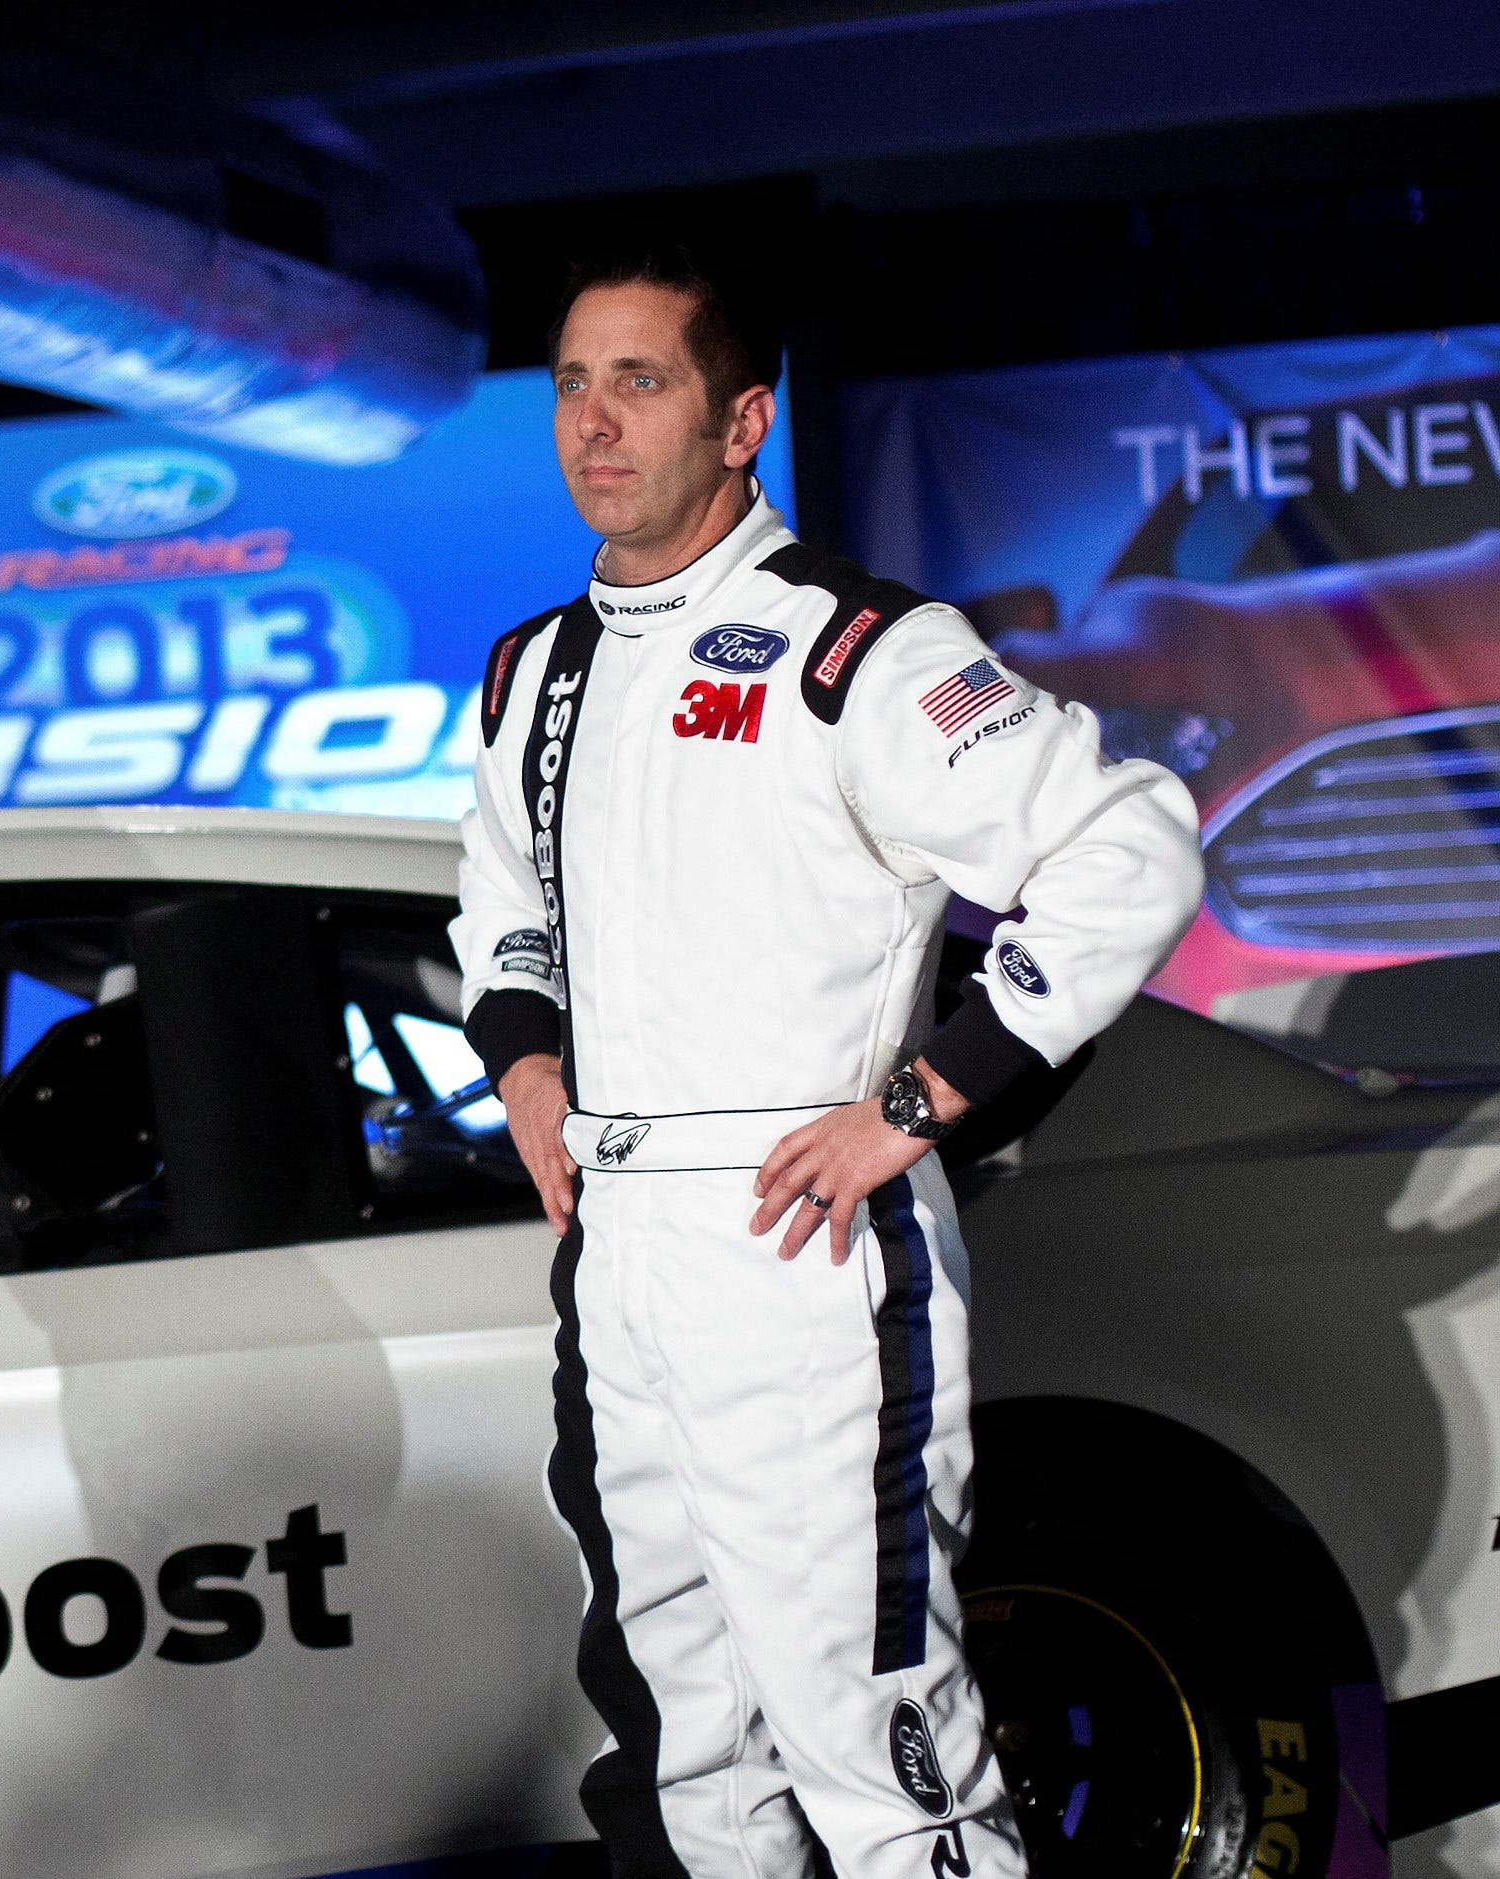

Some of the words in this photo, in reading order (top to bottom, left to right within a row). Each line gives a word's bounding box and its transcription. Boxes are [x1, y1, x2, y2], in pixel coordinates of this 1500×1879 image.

[1114, 415, 1313, 502] THE
[617, 595, 686, 615] RACING
[706, 631, 775, 664] Ford
[820, 613, 875, 681] SIMPSON
[673, 680, 767, 743] 3M
[536, 670, 582, 1010] EcoBoost
[1002, 948, 1038, 987] Ford
[898, 1725, 941, 1796] Ford
